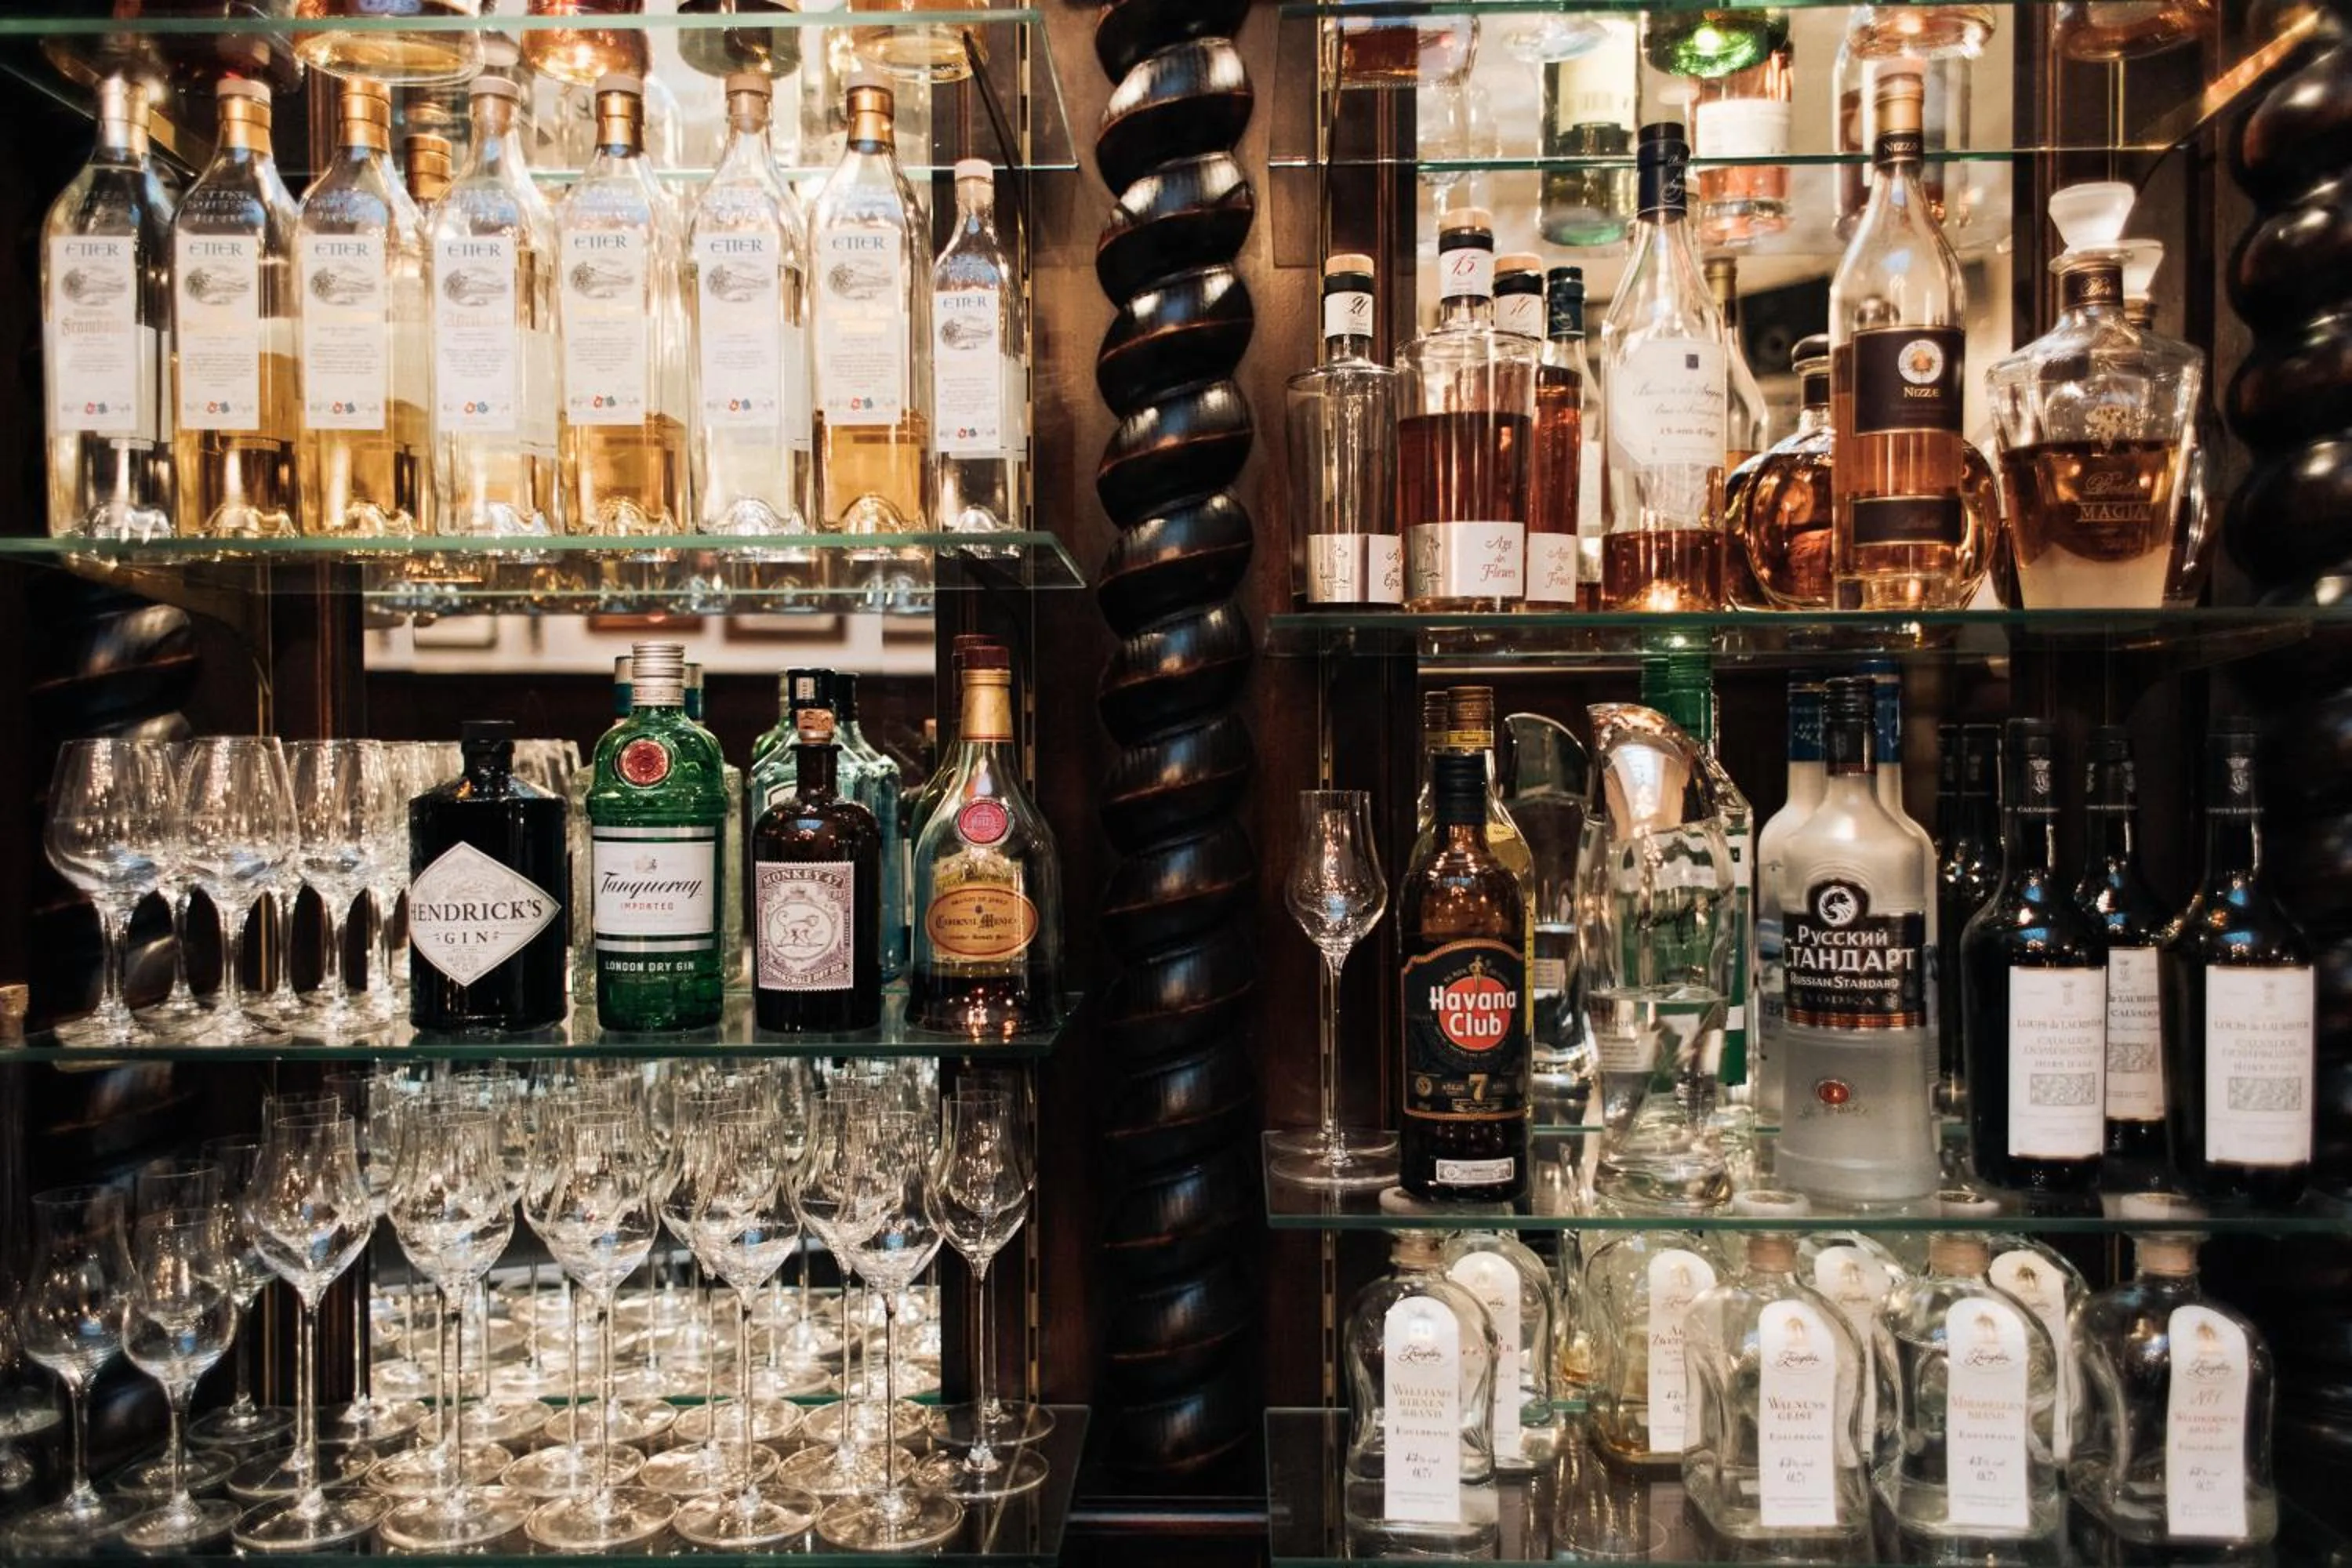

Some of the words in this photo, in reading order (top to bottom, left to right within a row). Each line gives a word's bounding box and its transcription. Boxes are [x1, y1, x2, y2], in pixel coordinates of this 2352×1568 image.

[600, 870, 703, 900] Tanqueray
[763, 869, 821, 884] MONKEY
[410, 898, 543, 922] HENDRICK'S
[620, 902, 674, 911] IMPORTED
[445, 931, 488, 945] GIN
[604, 960, 644, 972] LONDON
[648, 961, 673, 973] DRY
[675, 960, 696, 971] GIN
[1834, 975, 1900, 990] STANDARD
[1428, 985, 1518, 1011] Havana
[1448, 1011, 1502, 1037] Club
[1468, 1073, 1489, 1102] 7
